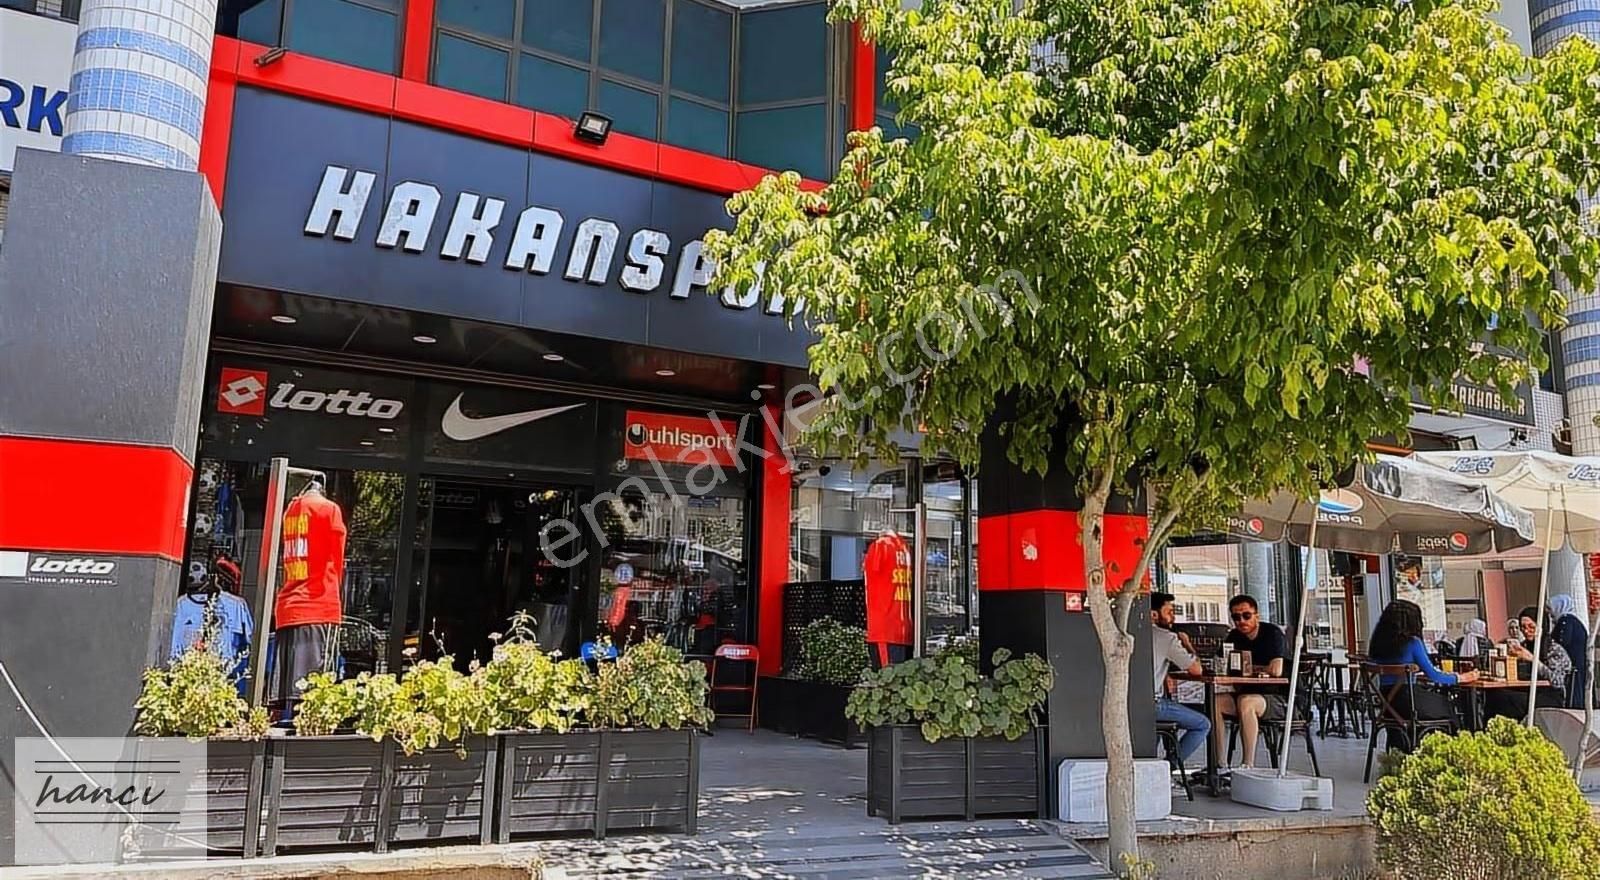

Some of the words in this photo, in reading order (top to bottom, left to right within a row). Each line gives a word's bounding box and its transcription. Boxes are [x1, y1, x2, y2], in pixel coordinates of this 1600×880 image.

[269, 382, 404, 419] lotto
[649, 425, 734, 451] uhlsport
[30, 557, 115, 574] lotto
